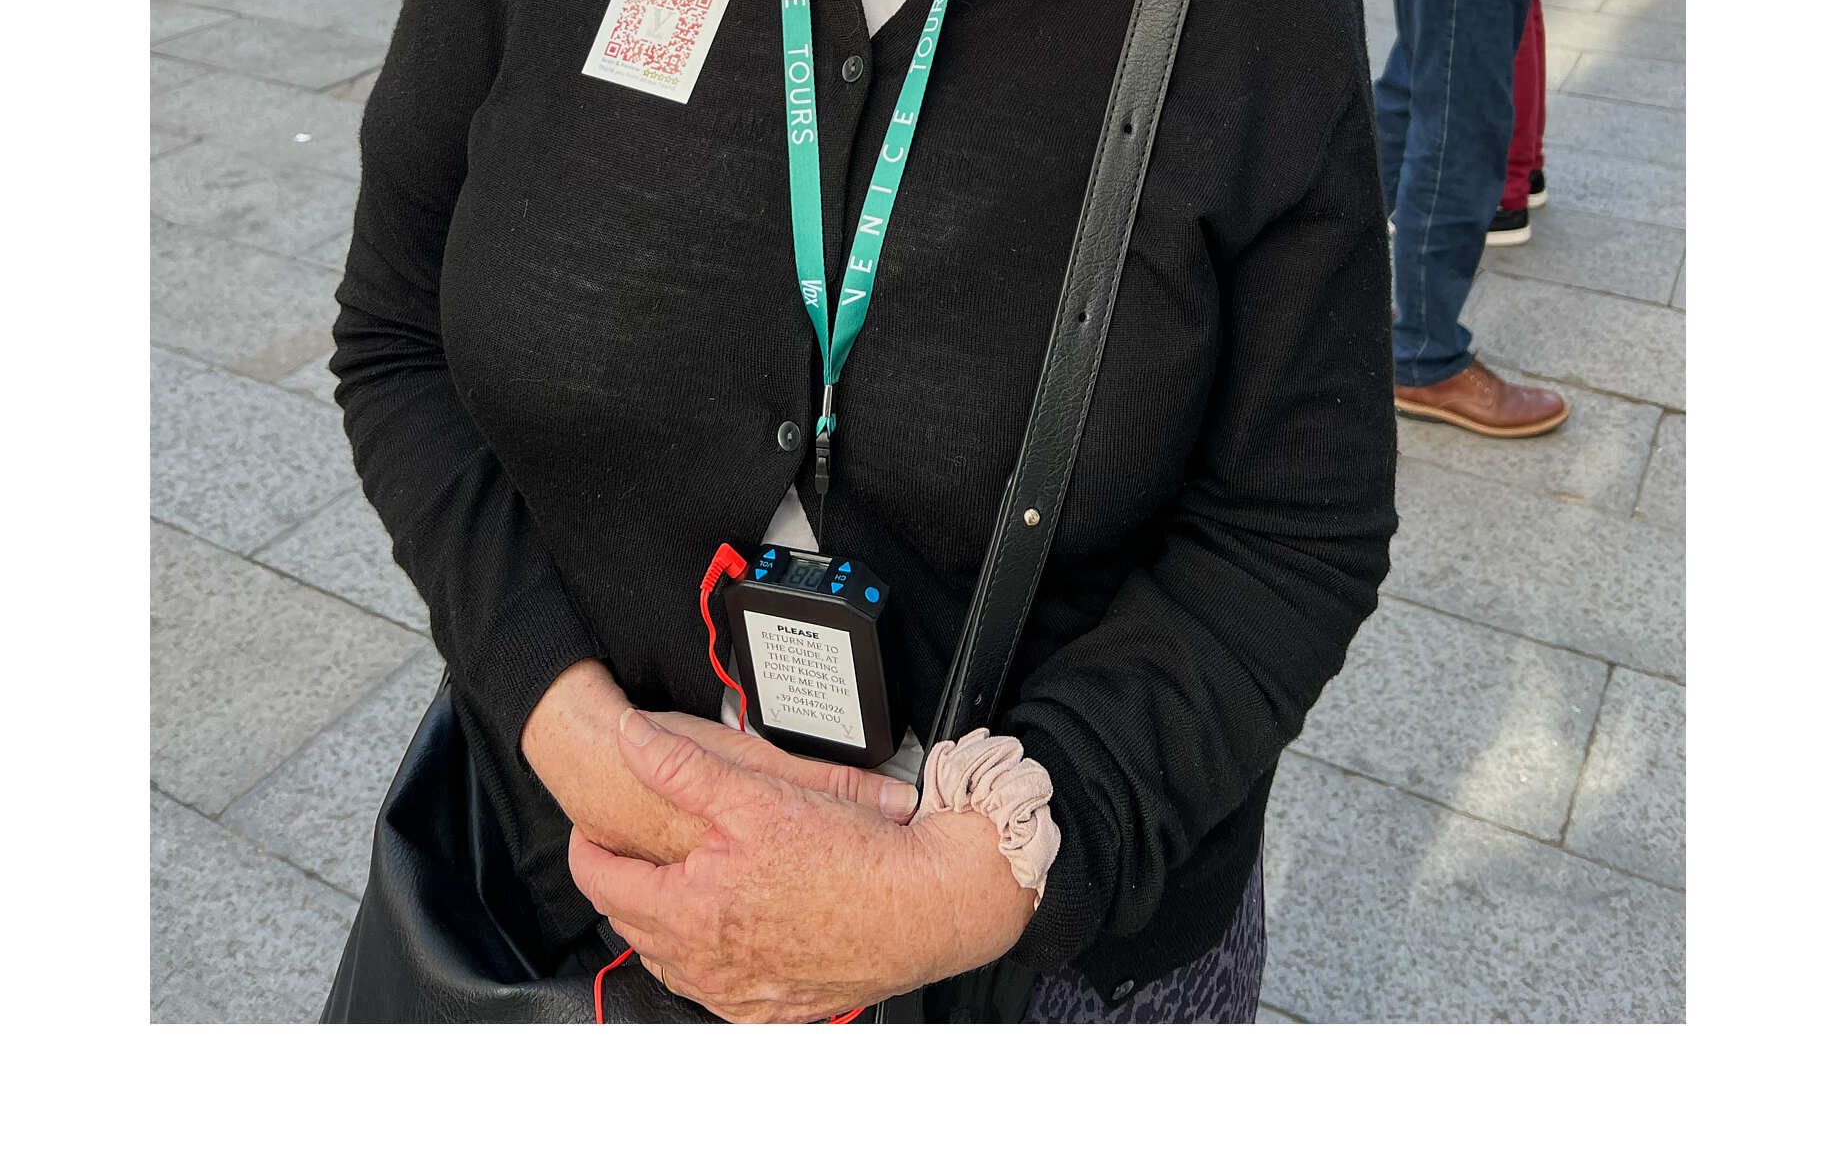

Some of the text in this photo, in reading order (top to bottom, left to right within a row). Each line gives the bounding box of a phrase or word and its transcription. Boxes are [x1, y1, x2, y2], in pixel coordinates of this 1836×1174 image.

[787, 43, 815, 146] TOURS
[841, 109, 915, 307] VENICE
[760, 560, 773, 569] VOL
[834, 574, 847, 582] CH
[761, 631, 839, 654] RETURN ME TO
[777, 625, 820, 640] PLEASE
[763, 642, 785, 652] THE
[826, 654, 839, 664] AT
[768, 652, 839, 674] THE MEETING
[763, 671, 851, 697] LEAVE ME IN THE
[764, 661, 847, 686] POINT KIOSK OR
[782, 704, 841, 724] THANK YOU
